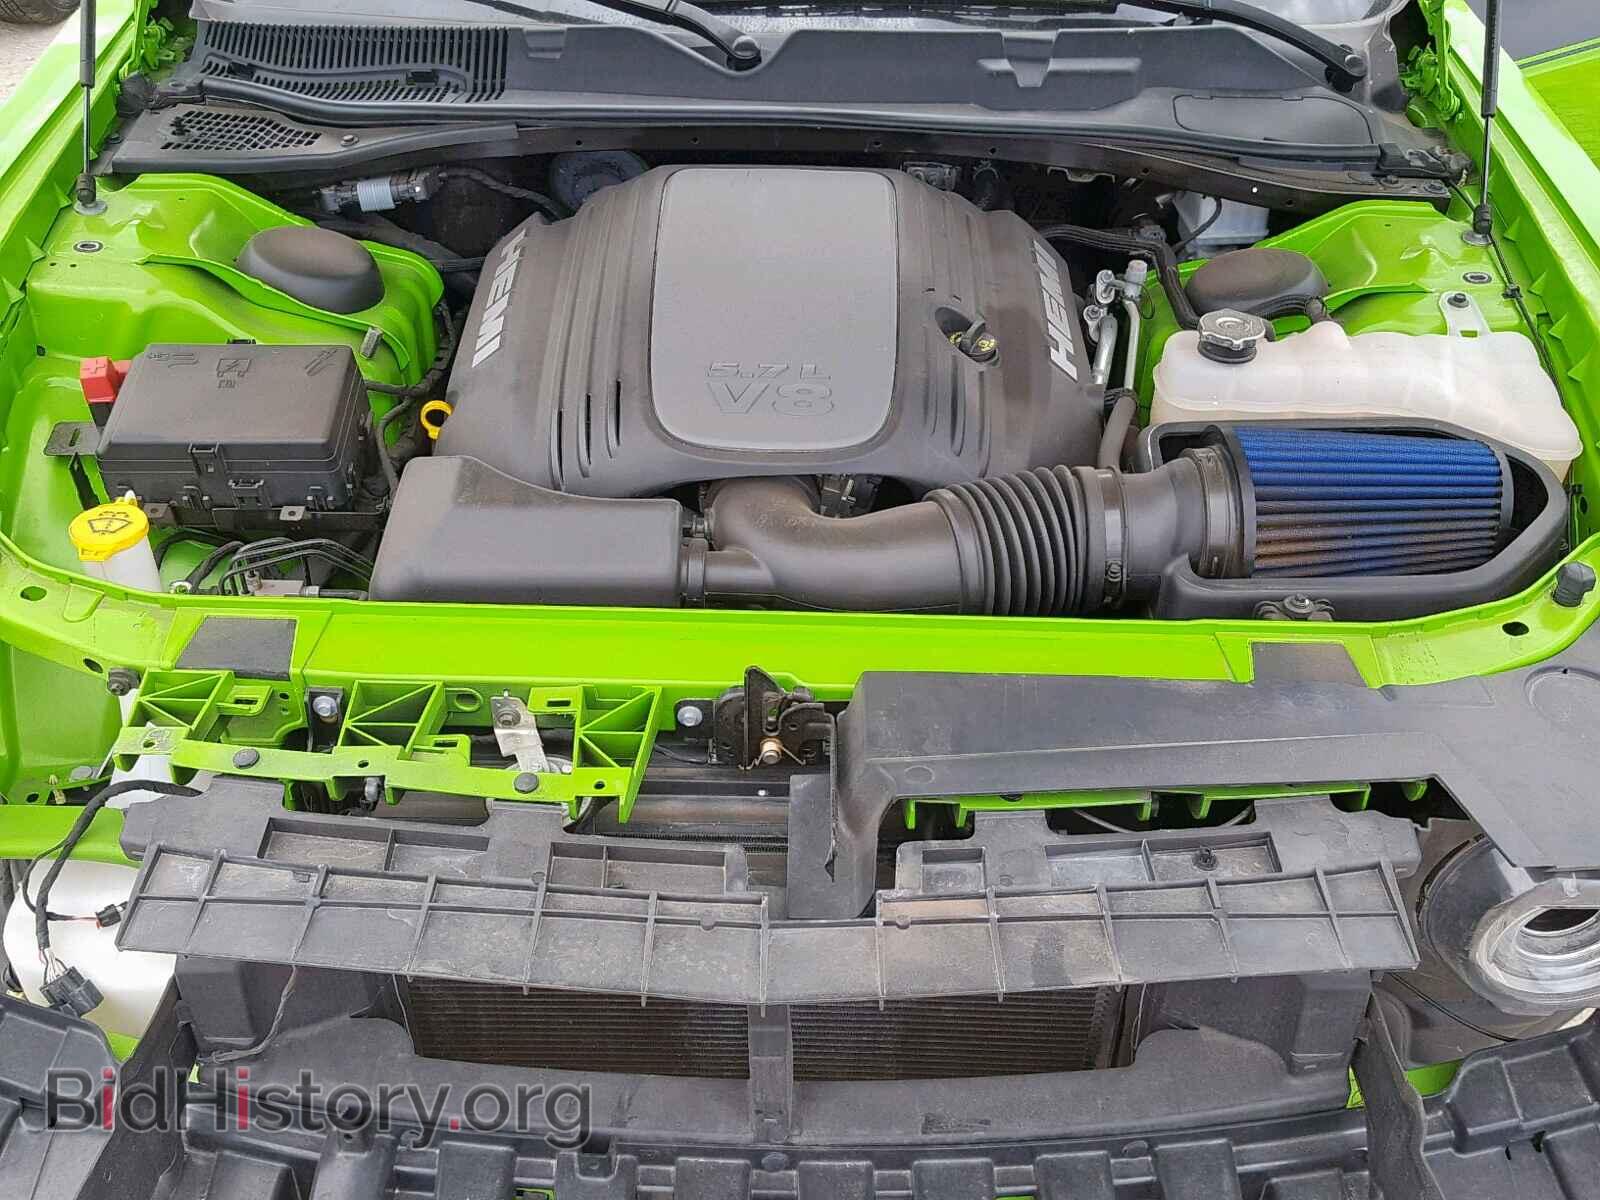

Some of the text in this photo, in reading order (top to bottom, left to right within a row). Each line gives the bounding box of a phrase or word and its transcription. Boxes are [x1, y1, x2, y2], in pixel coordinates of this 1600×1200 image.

[471, 227, 527, 369] HEMI
[1032, 239, 1078, 382] HEMI
[704, 381, 836, 418] V8
